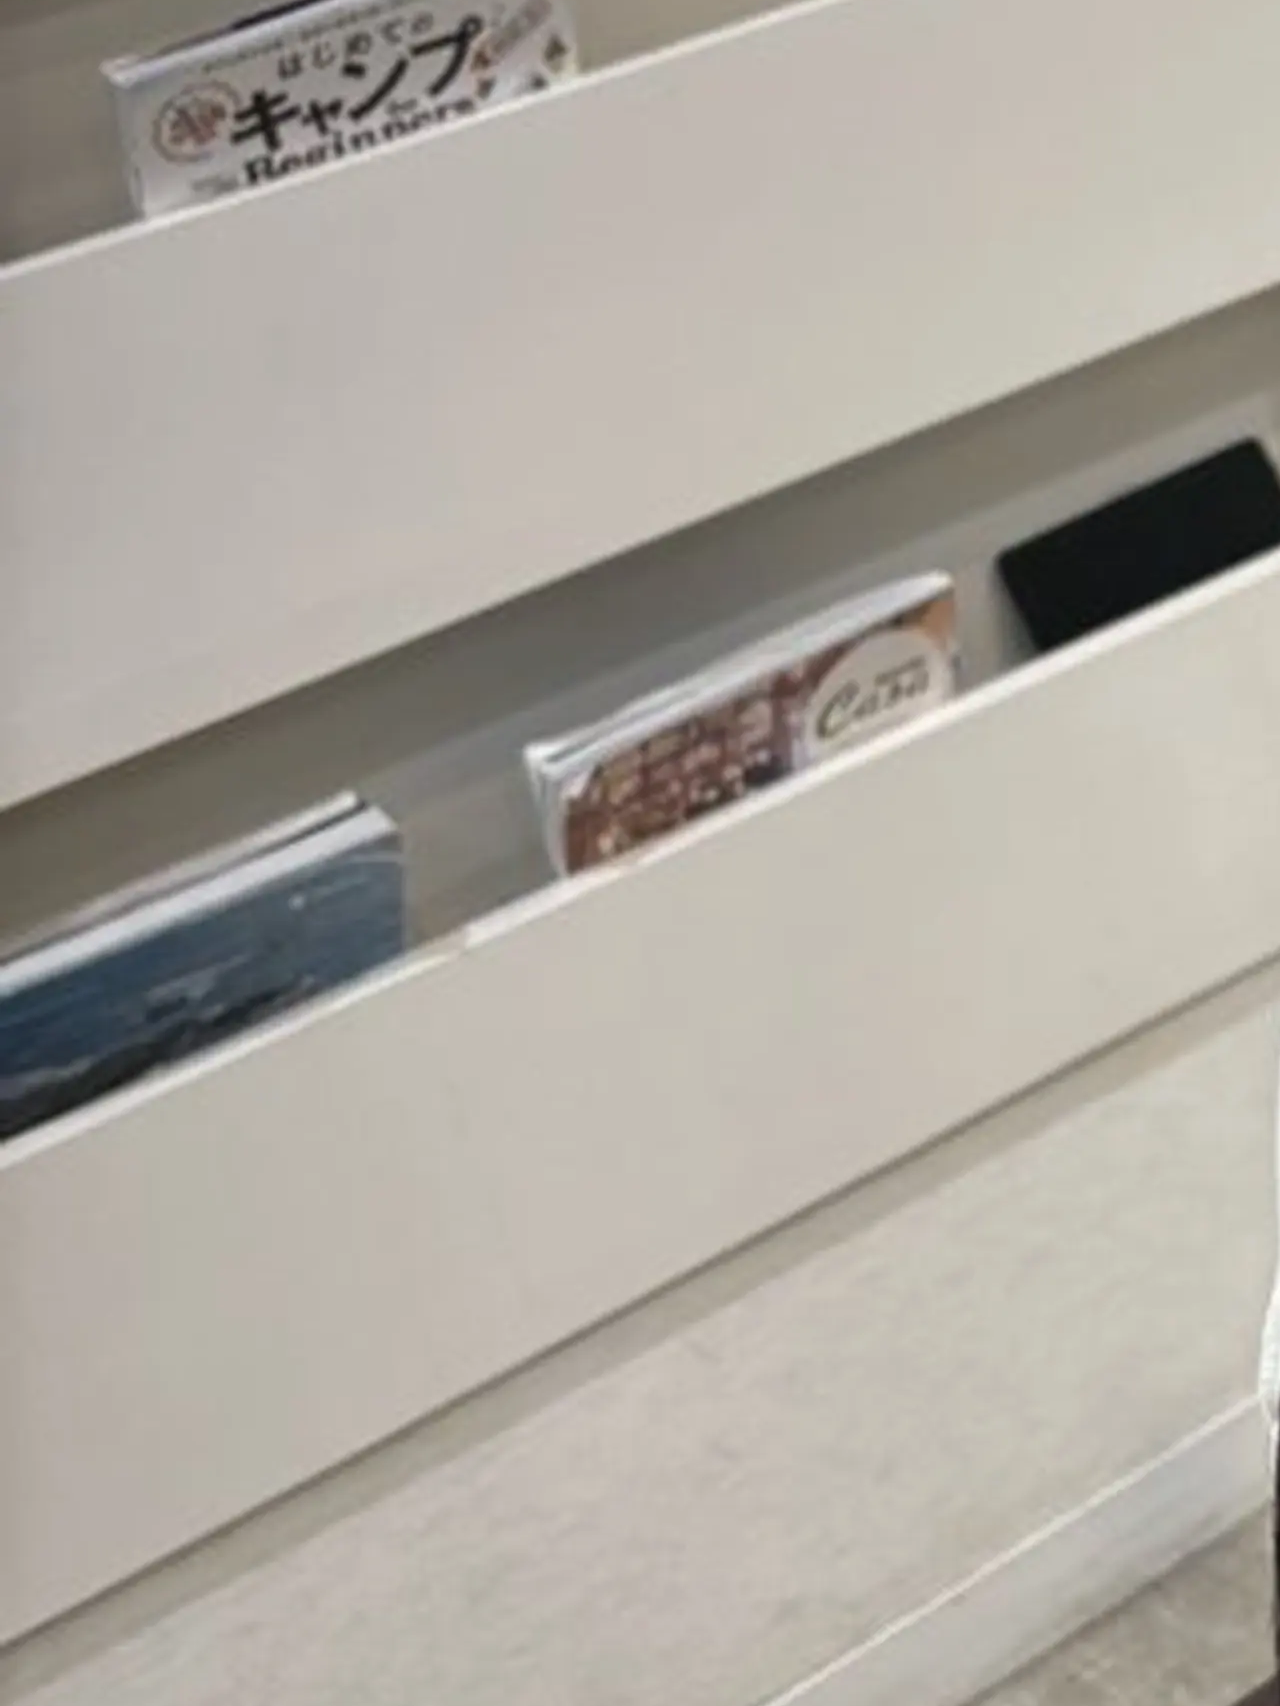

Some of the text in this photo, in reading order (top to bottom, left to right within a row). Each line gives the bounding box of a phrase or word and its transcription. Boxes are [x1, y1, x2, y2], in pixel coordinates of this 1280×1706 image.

[229, 14, 484, 153] キャンプ
[277, 11, 434, 81] はじめての
